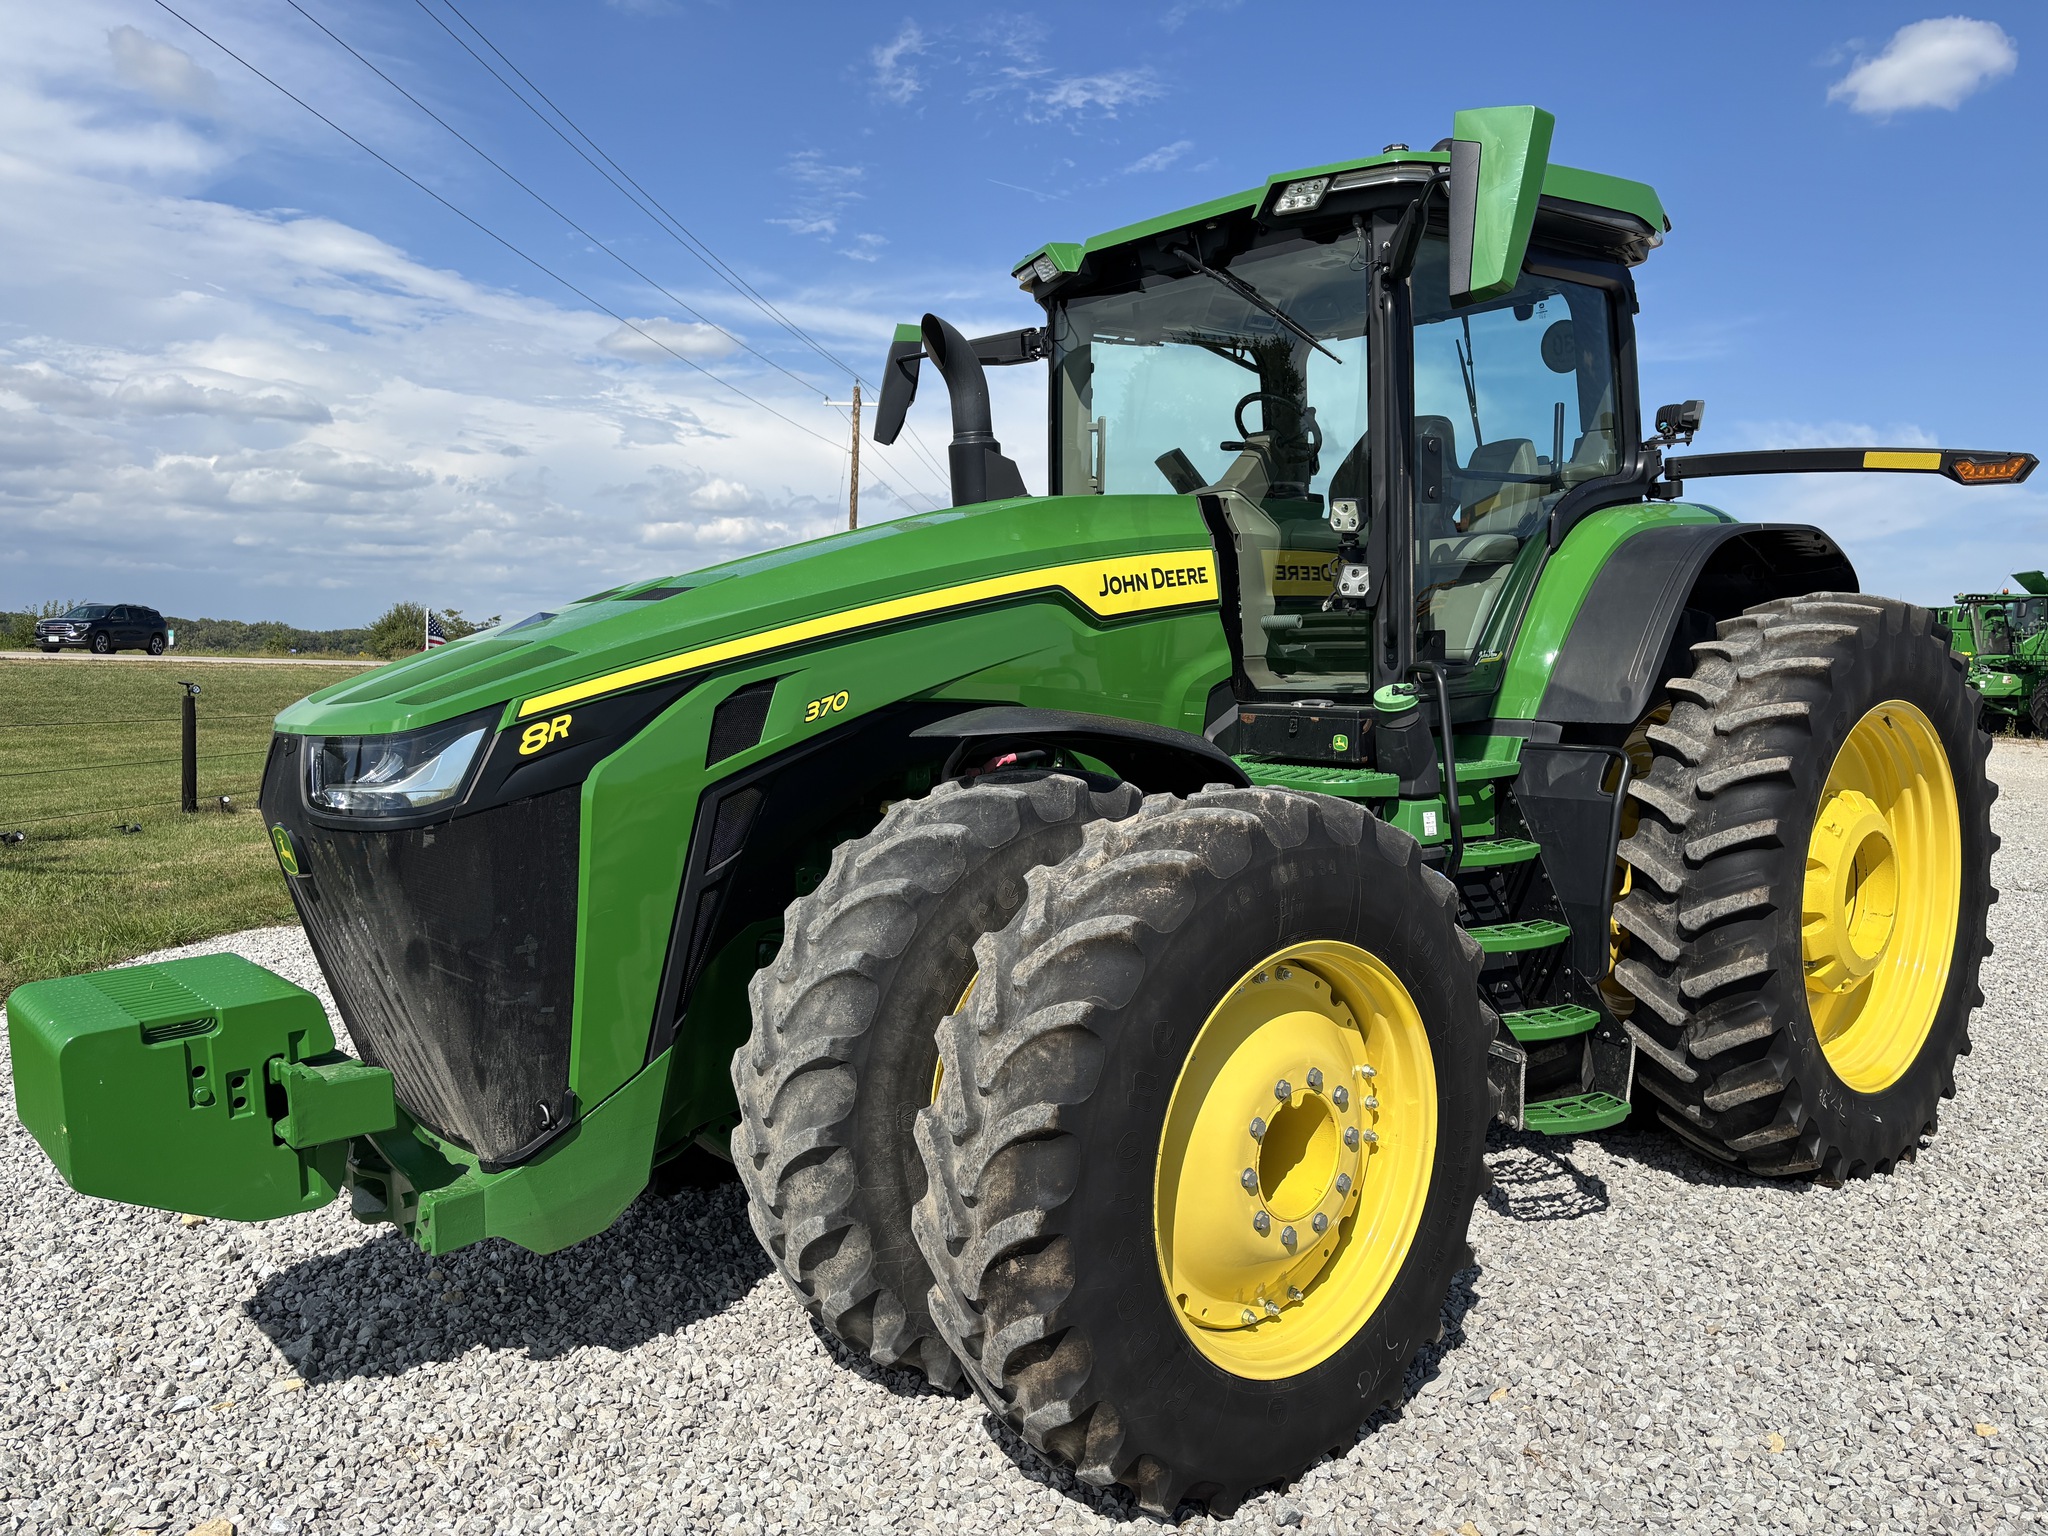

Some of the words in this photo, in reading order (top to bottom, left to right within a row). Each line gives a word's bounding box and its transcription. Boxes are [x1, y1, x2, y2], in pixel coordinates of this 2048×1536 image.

[1099, 573, 1149, 597] JOHN
[1151, 567, 1209, 590] DEERE
[803, 690, 850, 723] 370
[518, 714, 573, 755] 8R
